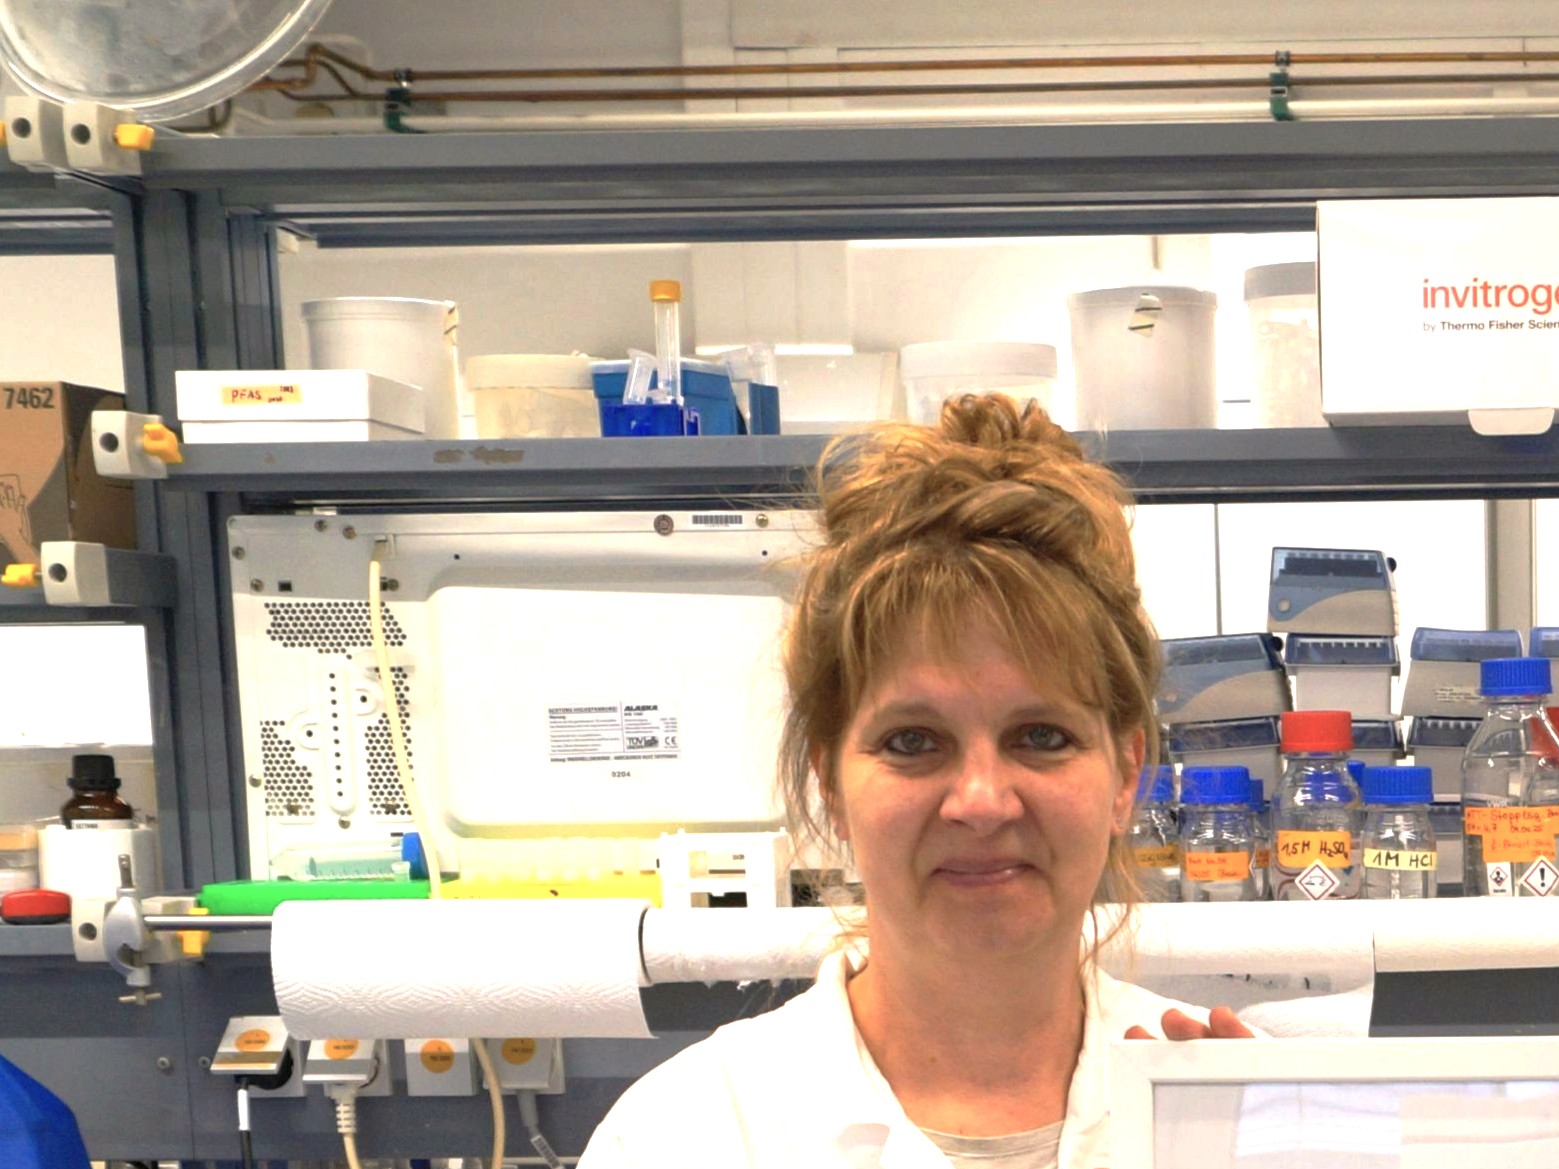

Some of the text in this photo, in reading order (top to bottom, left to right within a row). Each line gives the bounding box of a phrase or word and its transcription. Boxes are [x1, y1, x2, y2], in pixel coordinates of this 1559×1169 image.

[1423, 322, 1436, 332] by
[1440, 321, 1485, 330] Thermo
[1489, 320, 1524, 330] Fisher
[3, 387, 55, 410] 7462
[231, 389, 262, 403] PFAS
[624, 704, 658, 712] ALASKA
[1409, 853, 1433, 868] HCl
